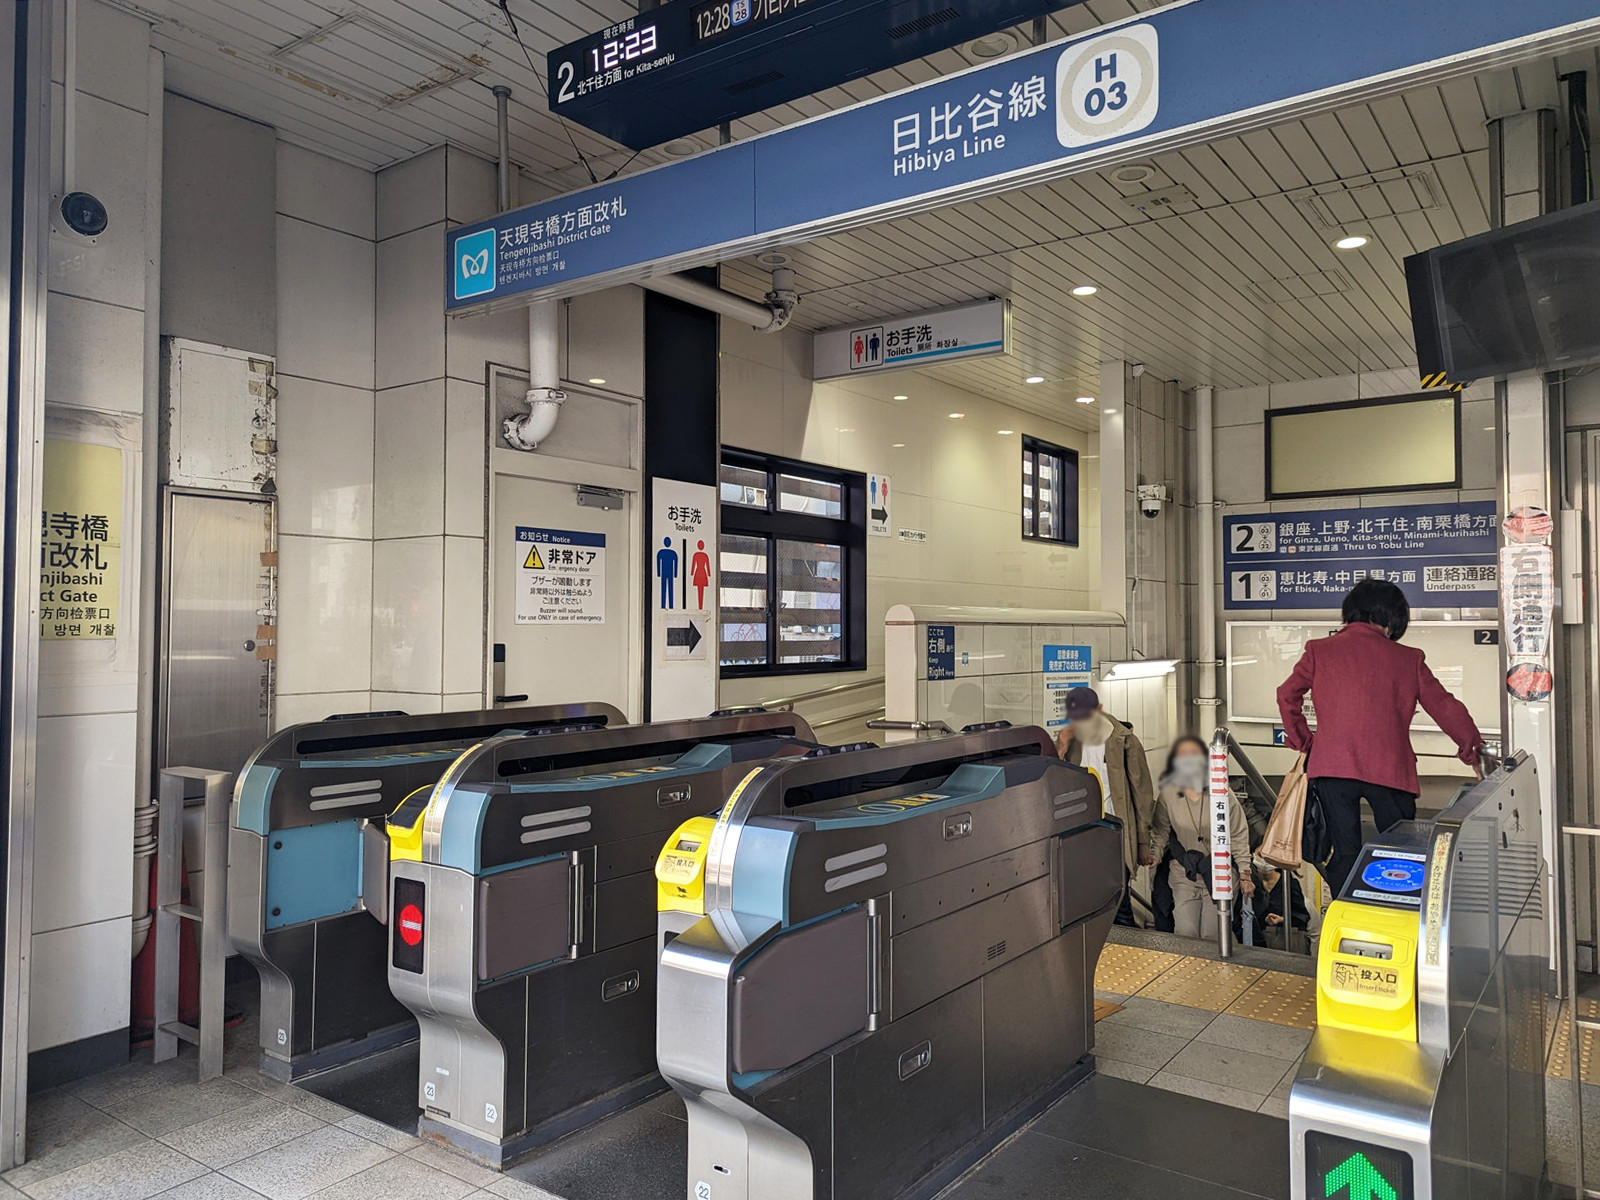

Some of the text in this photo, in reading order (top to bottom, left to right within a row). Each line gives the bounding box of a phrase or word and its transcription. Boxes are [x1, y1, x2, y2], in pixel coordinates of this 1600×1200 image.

[697, 3, 731, 39] 12:28
[735, 9, 748, 21] 28
[603, 20, 635, 39] 現在時刻
[592, 25, 657, 72] 12:23
[624, 53, 675, 79] for Kita-senju
[1094, 53, 1117, 83] H
[557, 61, 575, 104] 2
[577, 66, 622, 96] 北千住方面
[1084, 81, 1128, 117] 03
[892, 75, 1047, 155] 日比谷線
[893, 134, 1006, 176] Hibiya Line
[500, 195, 627, 249] 天現寺橋方面改札
[500, 223, 611, 261] Tengenjibashi District Gate
[886, 324, 932, 347] お手洗
[887, 347, 913, 358] Toilets
[936, 338, 959, 349] 화장실
[667, 505, 702, 525] お手洗
[675, 522, 695, 533] Toilets
[519, 531, 571, 544] お知らせ Notice
[1236, 525, 1255, 552] 2
[1279, 528, 1490, 545] for Ginza, Ueno, Kita-senju, Minami-kurihashi
[1343, 543, 1364, 551] Thru
[1379, 541, 1402, 549] Tobu
[1404, 540, 1425, 549] Line
[548, 548, 597, 566] 非常ドア
[531, 576, 592, 587] ブザーが鳴動します
[1426, 566, 1497, 582] 連絡通路
[1238, 573, 1251, 600] 1
[1279, 585, 1293, 593] for
[1295, 585, 1321, 594] Ebisu,
[1426, 583, 1476, 591] Underpass
[60, 589, 98, 603] Gate
[542, 597, 582, 605] ご注意ください
[1512, 548, 1545, 653] 右側通行
[40, 606, 110, 620] 方向检票口
[54, 623, 81, 637] 방면
[89, 623, 115, 636] 개찰
[1480, 631, 1492, 644] 2
[928, 638, 945, 654] 右側
[928, 657, 939, 666] Keep
[929, 666, 945, 680] Right
[1215, 801, 1227, 845] 右側通行
[676, 859, 695, 868] 投入口
[1360, 969, 1397, 985] 投入口
[426, 1085, 435, 1097] 23
[486, 1107, 495, 1119] 22
[698, 1185, 709, 1200] 22
